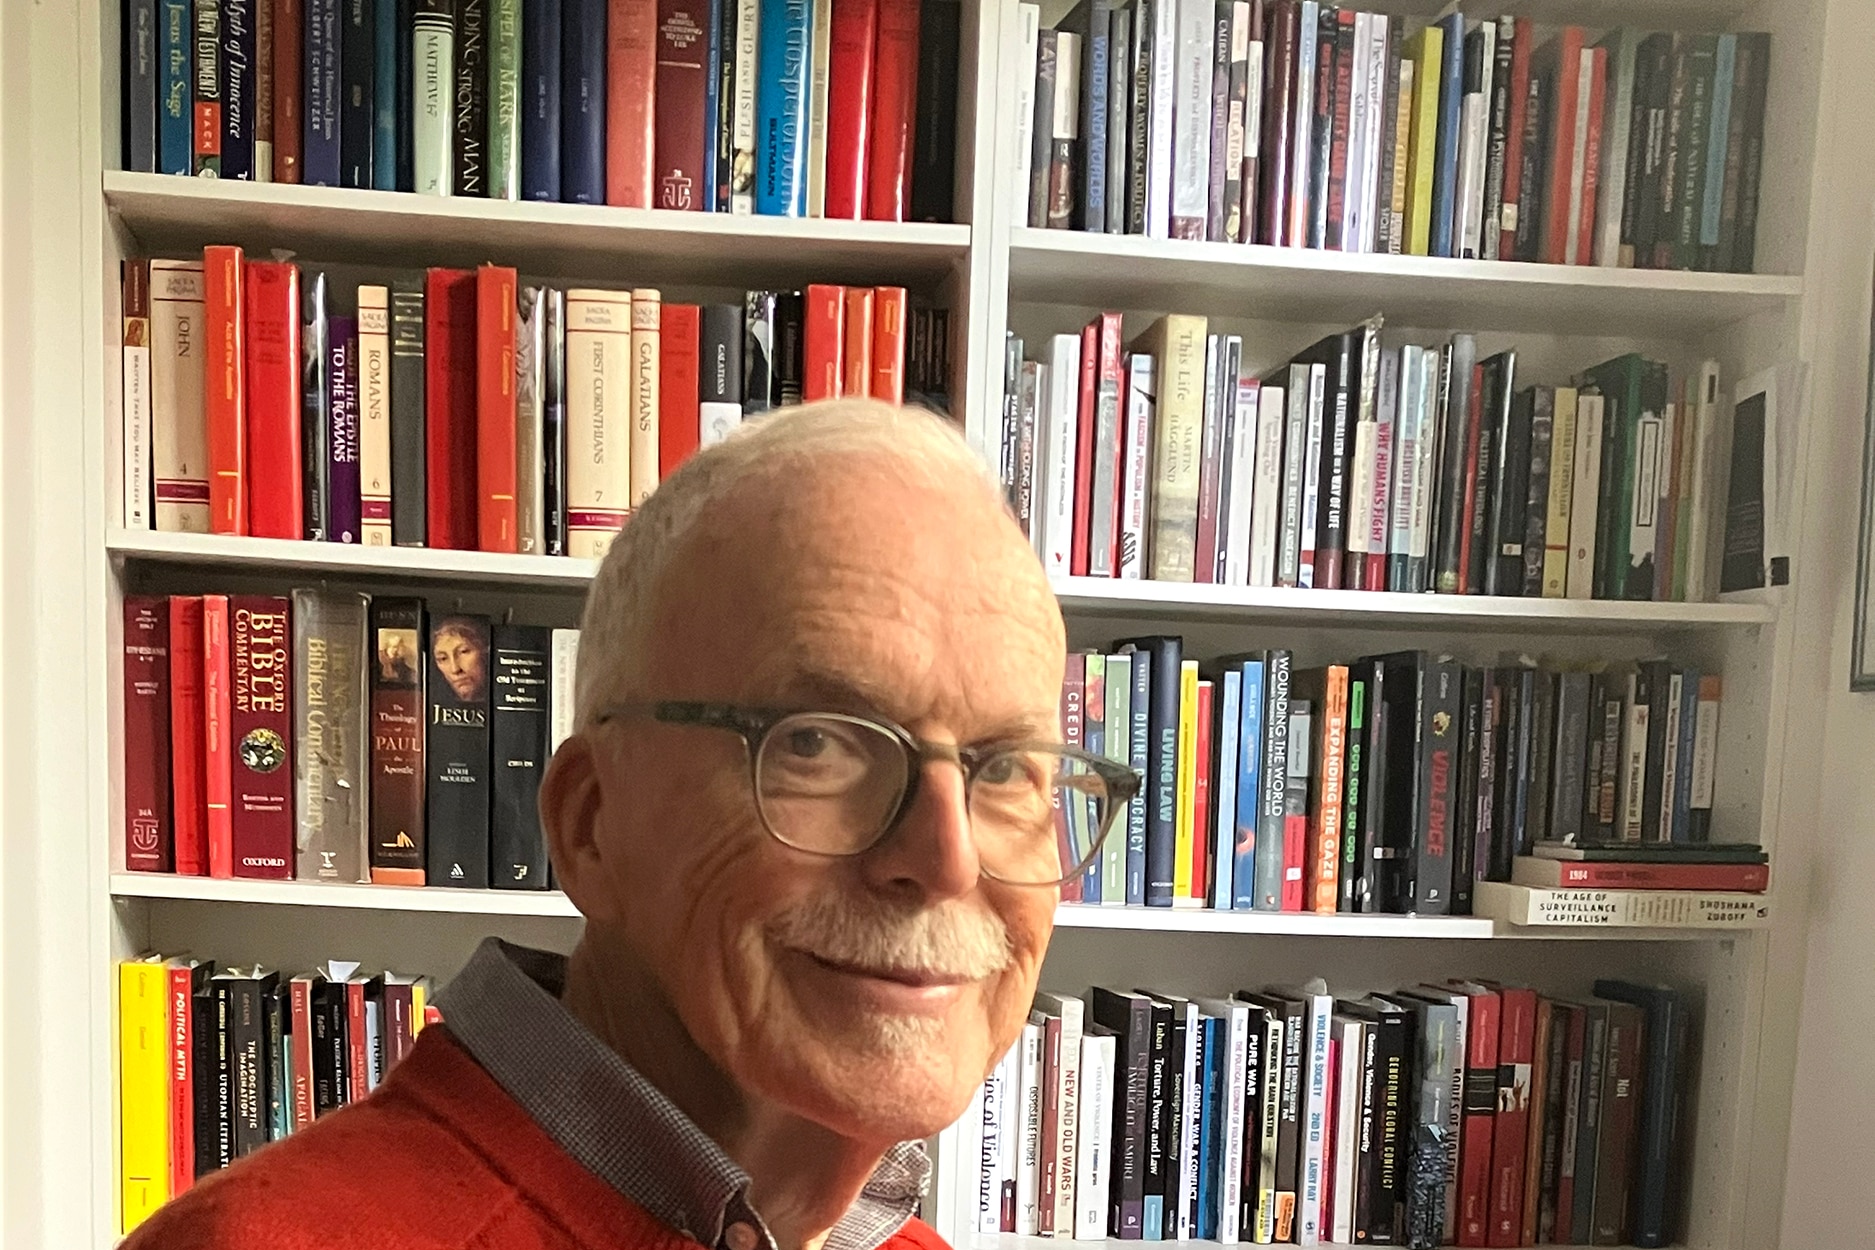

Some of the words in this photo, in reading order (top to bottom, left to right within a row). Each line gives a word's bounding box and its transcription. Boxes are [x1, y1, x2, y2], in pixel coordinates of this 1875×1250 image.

[166, 4, 186, 43] Jesus
[170, 49, 186, 75] the
[225, 39, 246, 62] of
[427, 34, 439, 104] MATTHEW
[1090, 35, 1107, 97] WORDS
[166, 81, 186, 118] Sage
[230, 61, 246, 139] Innocence
[311, 50, 321, 131] SCHWEITZER
[457, 68, 473, 134] STRONG
[499, 69, 517, 126] MARK
[203, 107, 213, 150] MACK
[1091, 98, 1105, 137] AND
[766, 117, 779, 197] BULTMANN
[1228, 102, 1242, 180] RELATIONS
[463, 137, 480, 194] MAN
[1088, 137, 1104, 210] WORLDS
[176, 315, 191, 358] JOHN
[332, 345, 346, 366] TO
[1177, 330, 1194, 365] This
[593, 340, 605, 376] FIRST
[716, 342, 727, 396] GALATIANS
[332, 368, 346, 396] THE
[345, 383, 358, 410] THE
[369, 349, 382, 421] ROMANS
[639, 341, 653, 433] GALATIANS
[1176, 370, 1191, 402] Life
[331, 399, 347, 464] ROMANS
[592, 377, 605, 466] CORINTHIANS
[1023, 406, 1034, 424] THE
[1333, 392, 1348, 457] NATIONALISM
[345, 412, 359, 464] EPISTLE
[1181, 425, 1194, 474] MARTIN
[1376, 421, 1392, 451] WHY
[1476, 430, 1491, 482] POLITICAL
[1330, 475, 1343, 496] WAY
[1373, 456, 1390, 507] HUMANS
[1020, 489, 1031, 521] POWER
[1286, 486, 1299, 528] BENEDICT
[1327, 510, 1340, 530] LIFE
[1329, 497, 1341, 509] OF
[1371, 508, 1386, 544] FIGHT
[1283, 528, 1297, 575] ANDERSON
[273, 610, 287, 641] THE
[235, 609, 250, 713] COMMENTARY
[250, 613, 277, 713] BIBLE
[272, 648, 287, 713] OXFORD
[307, 637, 328, 707] Biblical
[434, 703, 486, 726] JESUS
[1274, 656, 1291, 738] WOUNDING
[1067, 692, 1081, 748] CREDI
[1133, 713, 1147, 761] DIVINE
[376, 734, 421, 753] PAUL
[1161, 728, 1177, 783] LIVING
[1272, 740, 1286, 765] THE
[1327, 717, 1343, 804] EXPANDING
[303, 710, 327, 833] Commentary
[1131, 767, 1146, 853] DOCRACY
[1159, 785, 1174, 823] LAW
[1270, 766, 1285, 818] WORLD
[1426, 749, 1450, 858] VIOLENCE
[1325, 806, 1338, 836] THE
[242, 857, 286, 869] OXFORD
[1322, 839, 1336, 880] GAZE
[1539, 903, 1617, 913] SURVEILLANCE
[1551, 893, 1570, 901] THE
[1573, 893, 1592, 901] AGE
[1594, 893, 1607, 901] OF
[1545, 914, 1609, 923] CAPITALISM
[175, 992, 187, 1047] POLITICAL
[1154, 1022, 1167, 1050] Luban
[1313, 1014, 1327, 1053] VIOLENCE
[175, 1050, 188, 1081] MYTH
[247, 1040, 257, 1060] THE
[1233, 1052, 1243, 1084] POLITICAL
[1247, 1034, 1259, 1067] PURE
[1365, 1033, 1376, 1068] Gender,
[218, 1073, 228, 1120] UTOPIAN
[239, 1052, 249, 1118] IMAGINATION
[248, 1062, 258, 1129] APOCALYPTIC
[1063, 1069, 1076, 1098] NEW
[1151, 1057, 1166, 1099] Torture,
[1169, 1072, 1184, 1112] Sovereign
[1246, 1068, 1257, 1097] WAR
[1268, 1071, 1278, 1085] THE
[1311, 1063, 1324, 1097] SOCIETY
[1363, 1069, 1374, 1106] Violence
[1385, 1056, 1400, 1108] GENDERING
[1026, 1086, 1041, 1132] DISPOSABLE
[1062, 1100, 1075, 1127] AND
[1150, 1099, 1163, 1132] Power,
[1383, 1110, 1398, 1143] GLOBAL
[1449, 1112, 1460, 1128] OF
[1025, 1133, 1038, 1168] FUTURES
[1061, 1129, 1074, 1153] OLD
[1150, 1133, 1162, 1153] and
[1360, 1116, 1372, 1153] Security
[1059, 1156, 1073, 1192] WARS
[1149, 1153, 1161, 1175] Law
[1307, 1157, 1319, 1184] LARRY
[1381, 1146, 1396, 1190] CONFLICT
[1306, 1185, 1317, 1202] RAY
